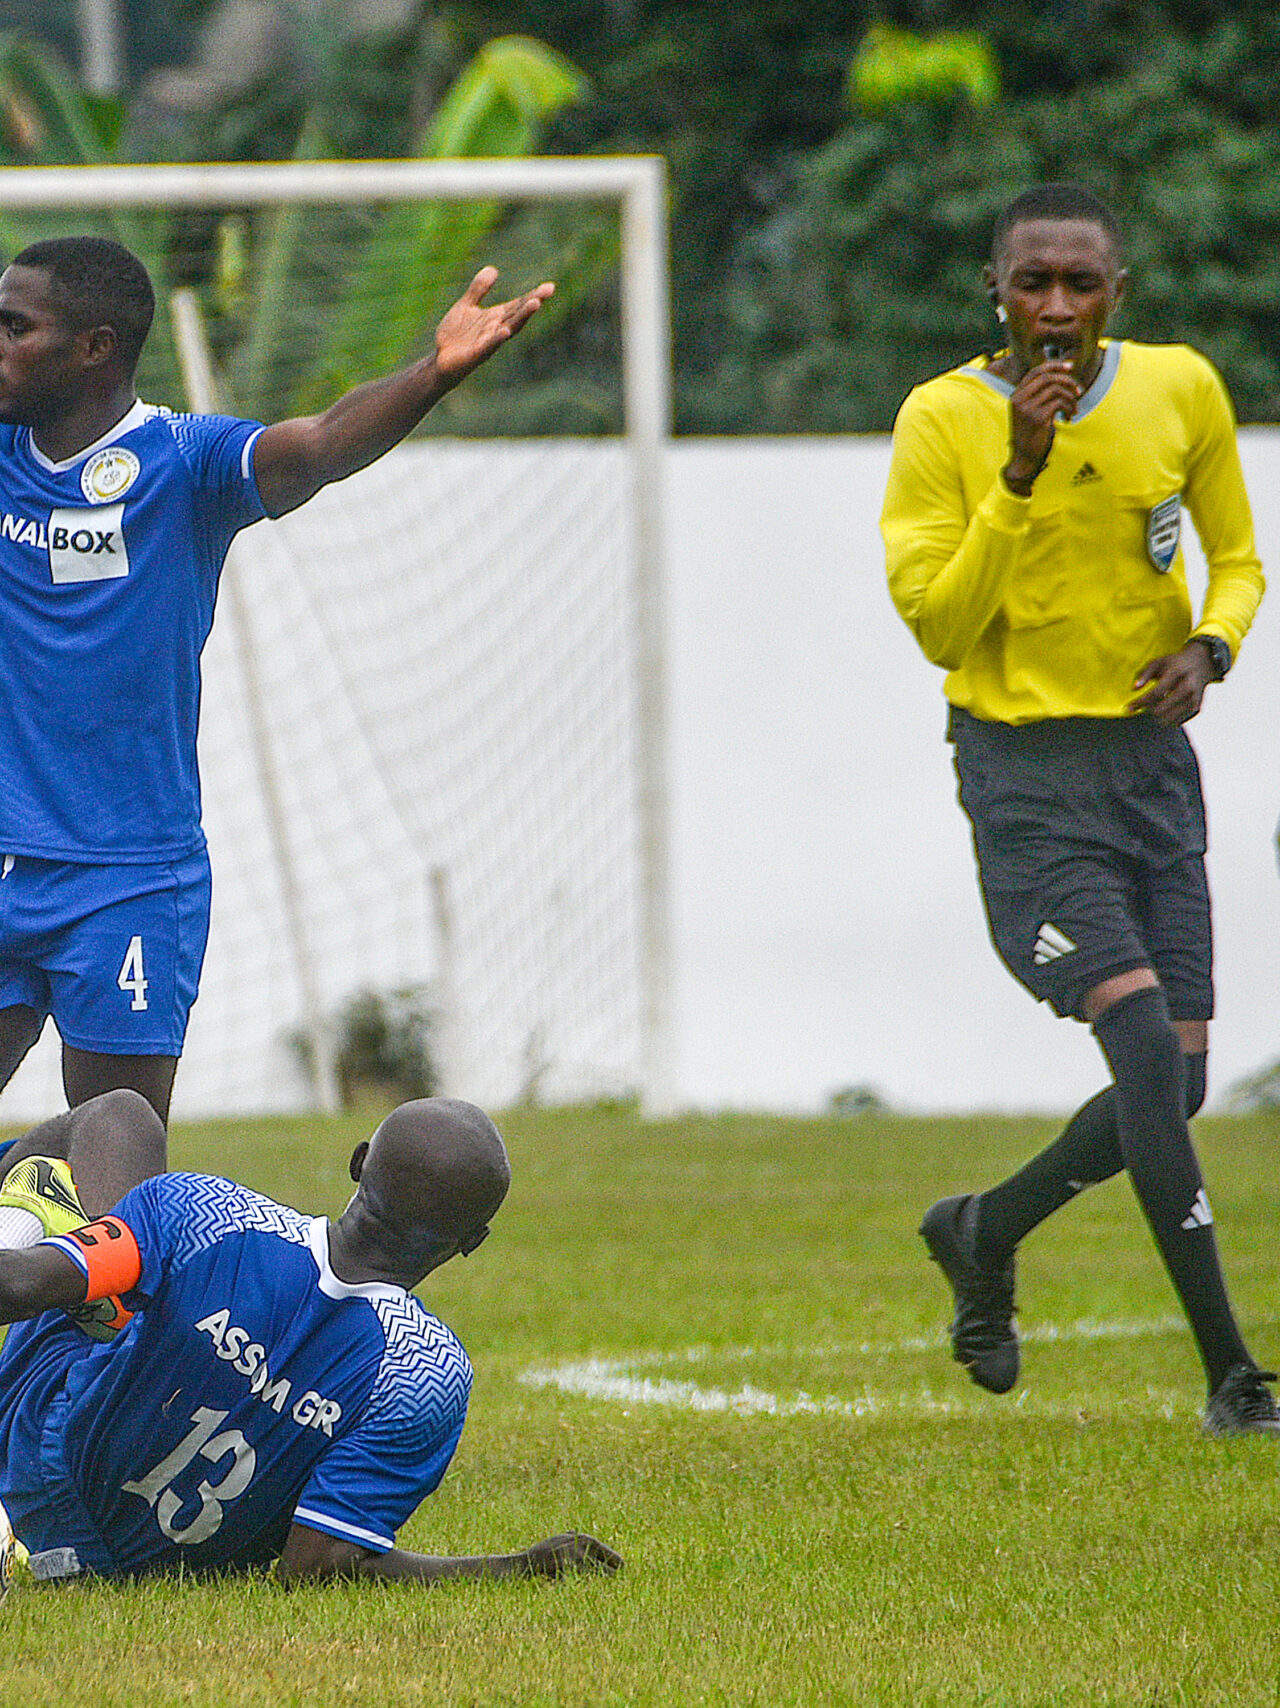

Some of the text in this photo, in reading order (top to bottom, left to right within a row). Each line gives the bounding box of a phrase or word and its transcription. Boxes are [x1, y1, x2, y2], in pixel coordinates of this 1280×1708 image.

[117, 935, 149, 1011] 4
[292, 1390, 343, 1438] GR
[121, 1406, 257, 1544] 13
